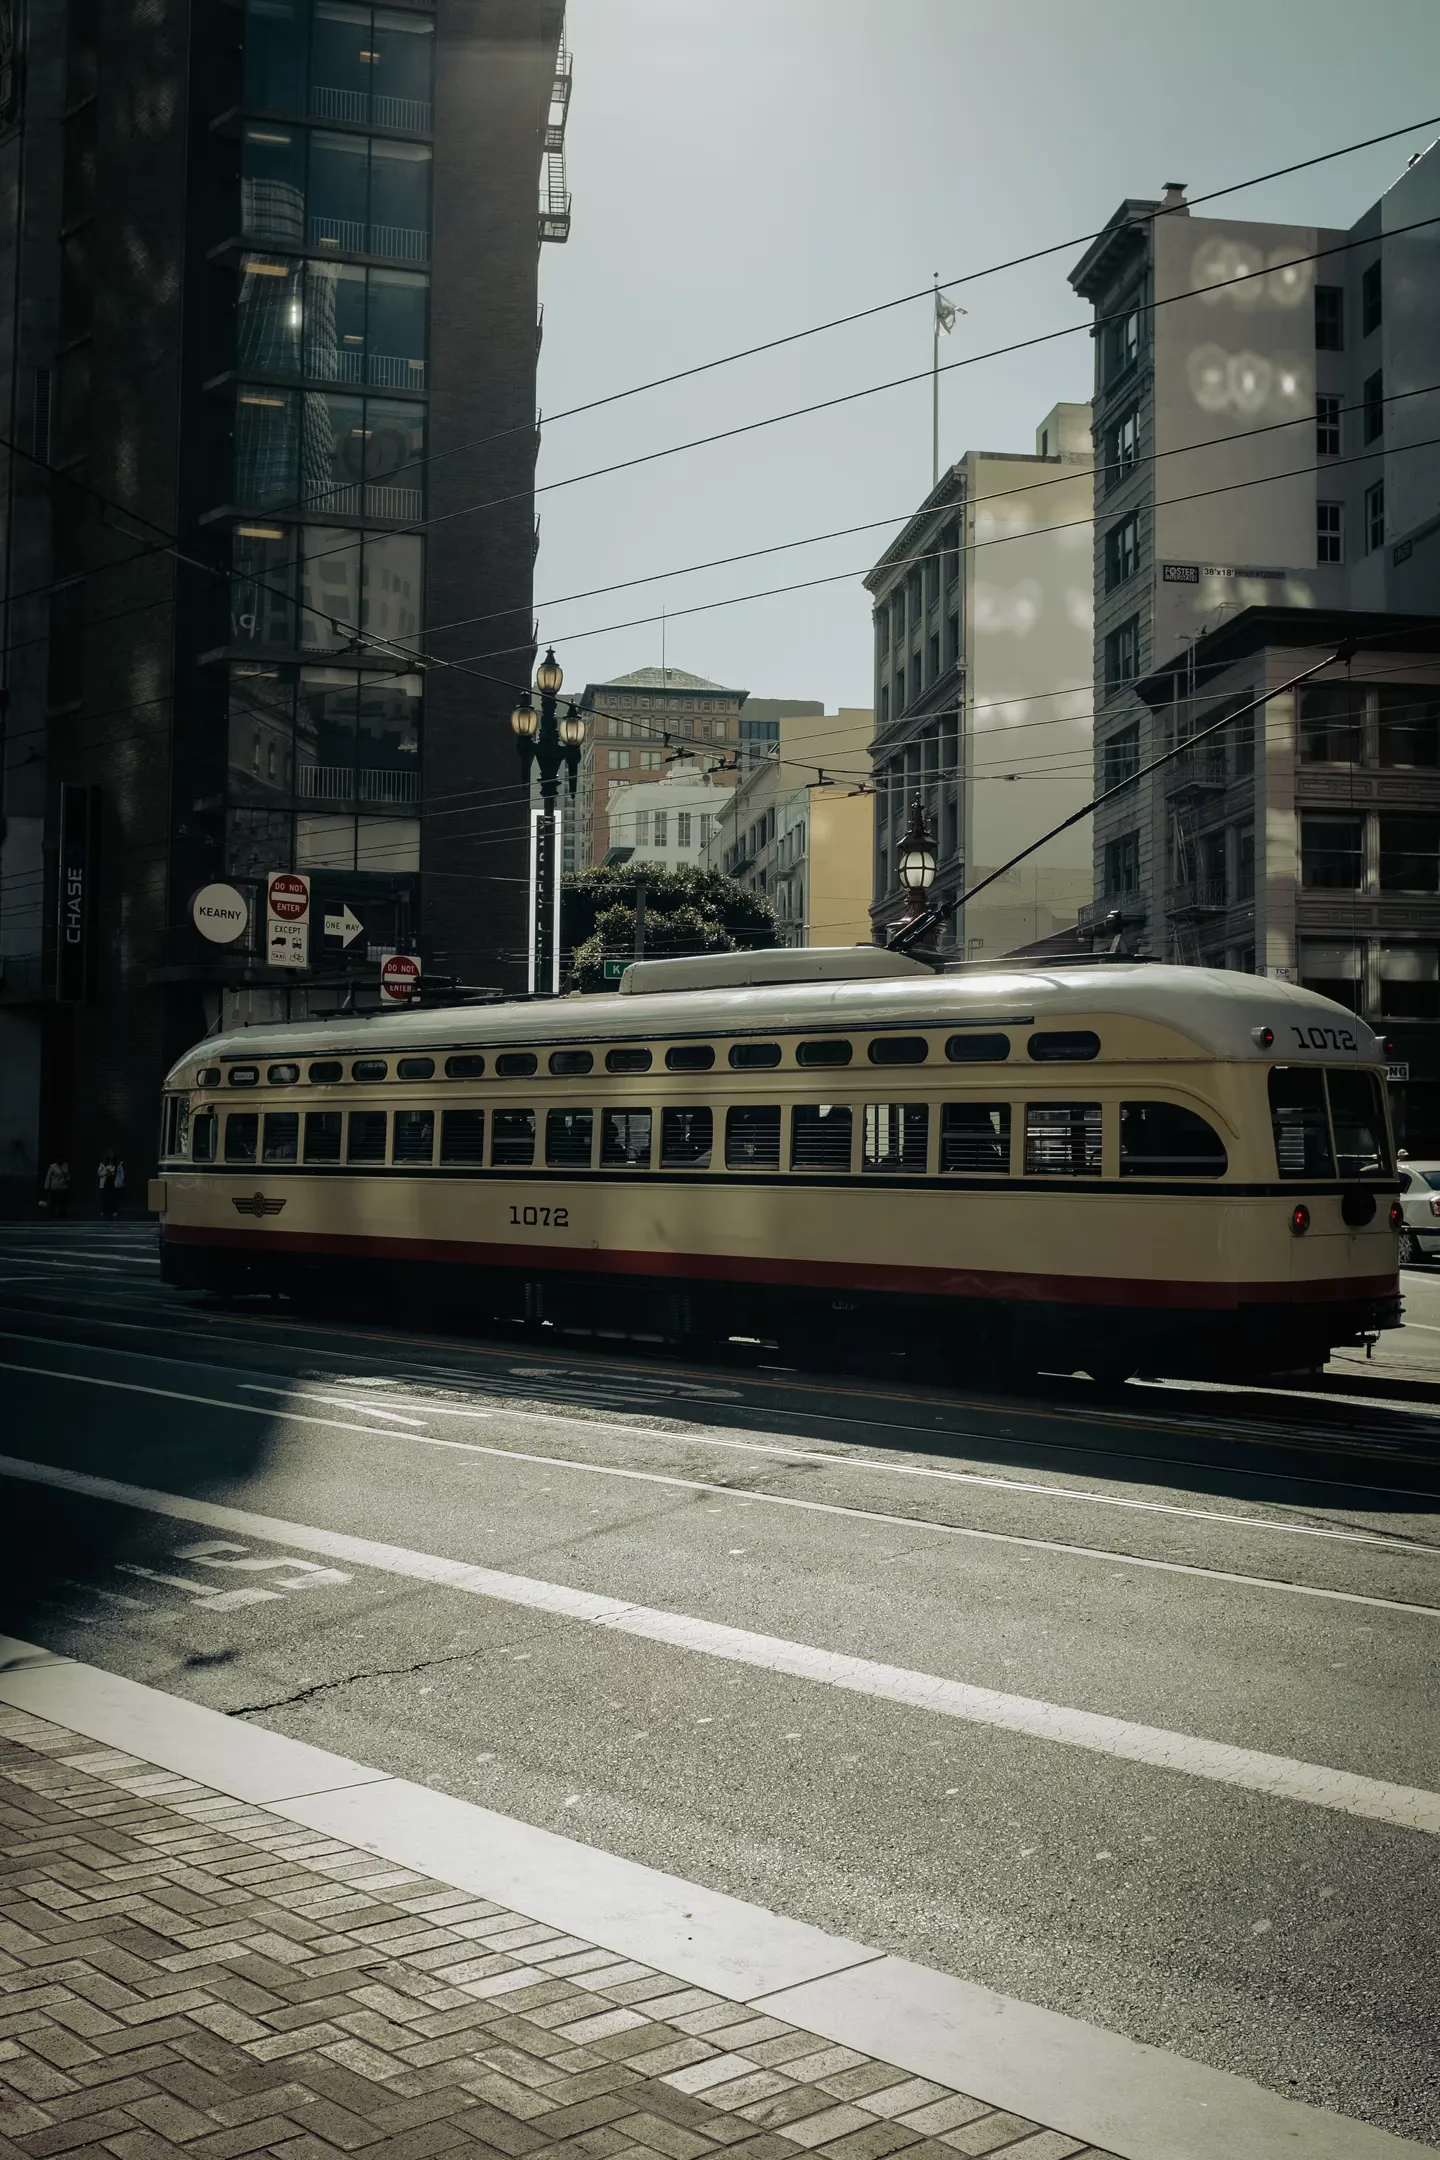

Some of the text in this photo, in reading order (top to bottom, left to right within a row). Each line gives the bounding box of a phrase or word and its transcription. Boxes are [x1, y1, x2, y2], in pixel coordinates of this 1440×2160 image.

[1164, 566, 1195, 577] FOSTER
[274, 882, 304, 893] DO NOT
[66, 867, 83, 944] CHASE
[277, 902, 300, 913] ENTER
[199, 906, 242, 920] KEARNY
[274, 925, 301, 935] EXCEPT
[325, 921, 360, 932] ONE WAY
[387, 963, 415, 973] DO NOT
[1290, 1027, 1358, 1051] 1072
[509, 1205, 569, 1228] 1072
